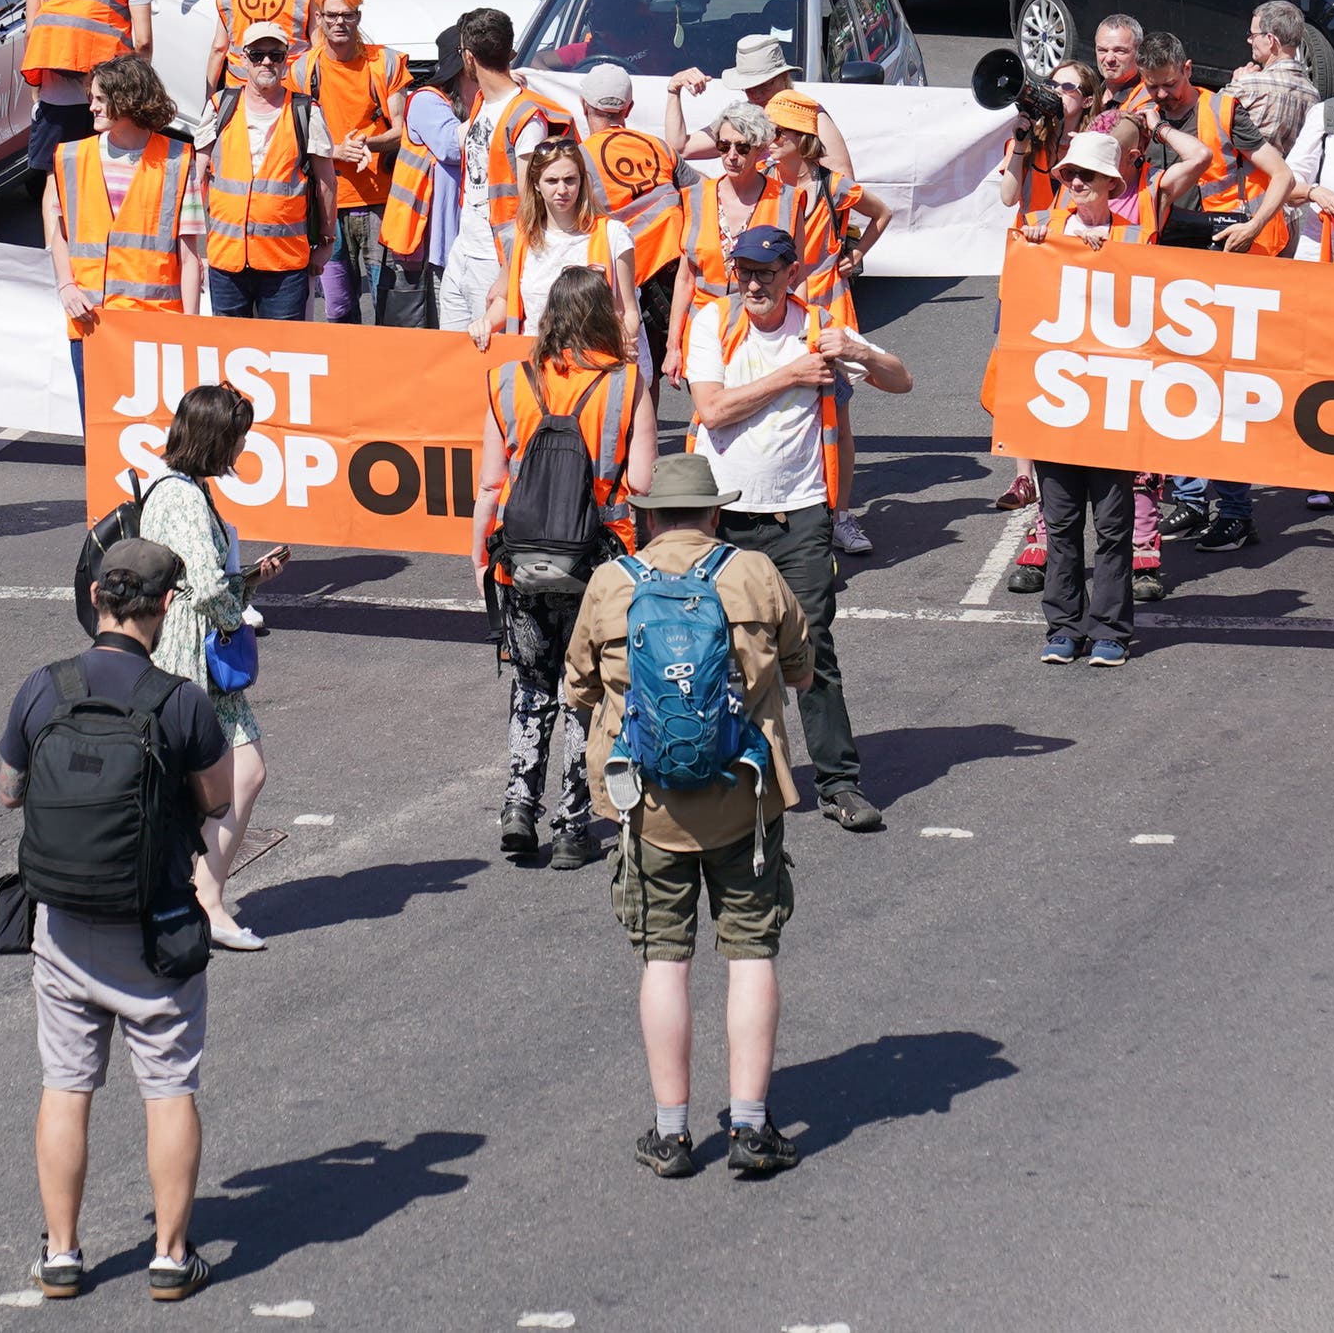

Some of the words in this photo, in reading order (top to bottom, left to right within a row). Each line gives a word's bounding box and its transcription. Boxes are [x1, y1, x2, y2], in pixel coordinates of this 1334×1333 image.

[1031, 266, 1280, 360] JUST
[1027, 350, 1284, 443] STOP
[115, 423, 338, 508] SOP
